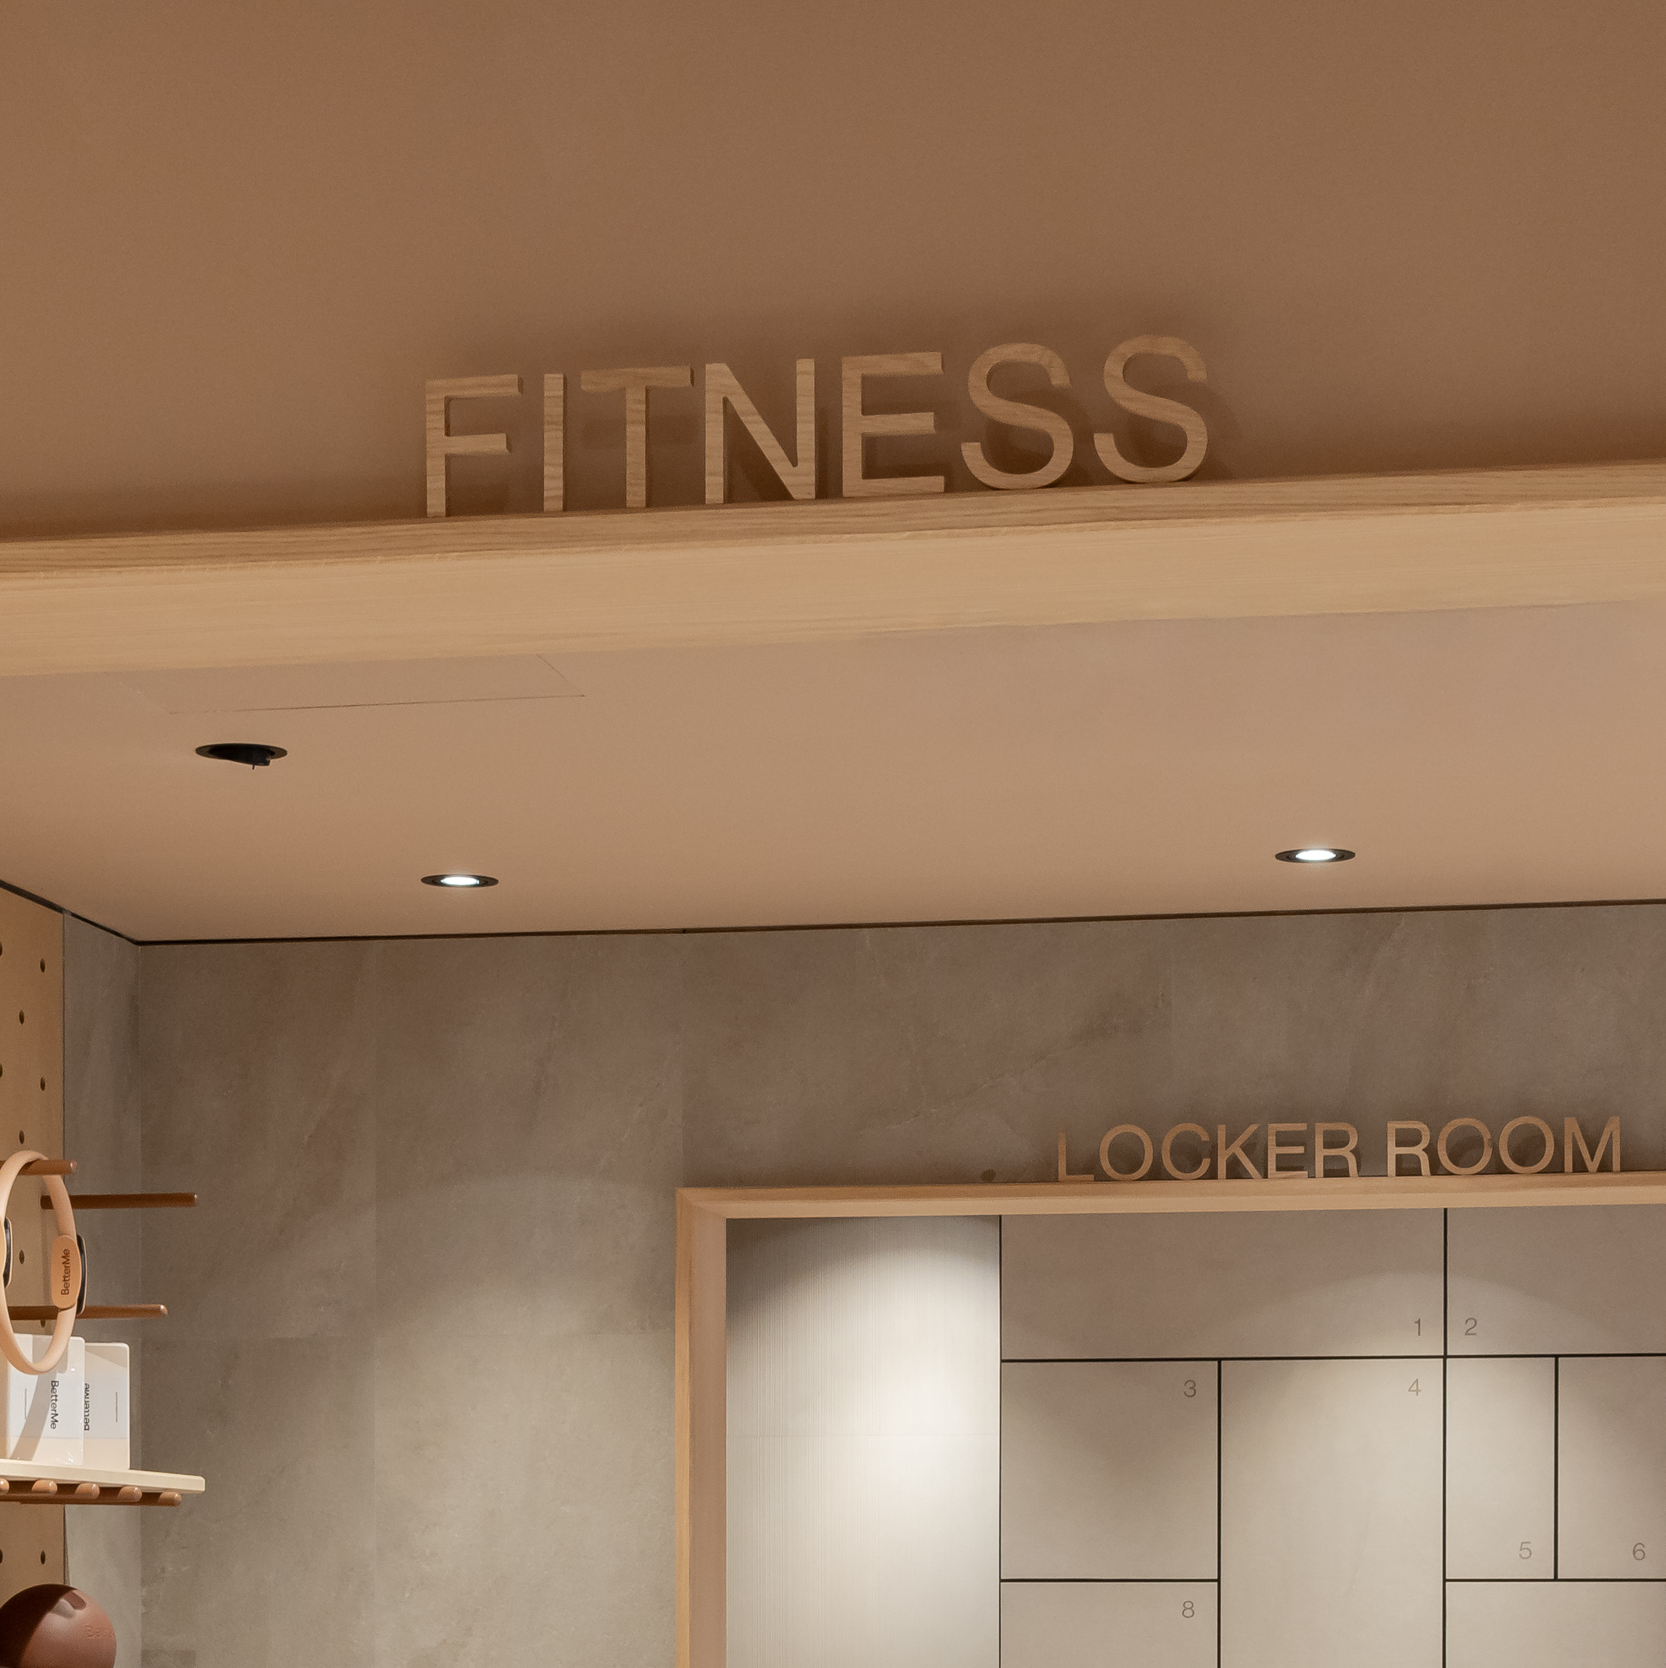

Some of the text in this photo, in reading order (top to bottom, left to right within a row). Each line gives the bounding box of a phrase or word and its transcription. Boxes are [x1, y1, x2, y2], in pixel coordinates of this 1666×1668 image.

[425, 333, 1208, 518] FITNESS
[1058, 1115, 1621, 1182] LOCKER ROOM
[61, 1248, 70, 1296] BetterMe
[1413, 1318, 1422, 1336] 1
[1464, 1317, 1478, 1336] 2
[1183, 1379, 1197, 1398] 3
[1407, 1378, 1422, 1396] 4
[50, 1380, 59, 1430] BetterMe
[1518, 1541, 1533, 1560] 5
[1632, 1542, 1646, 1561] 6
[1181, 1600, 1195, 1619] 8
